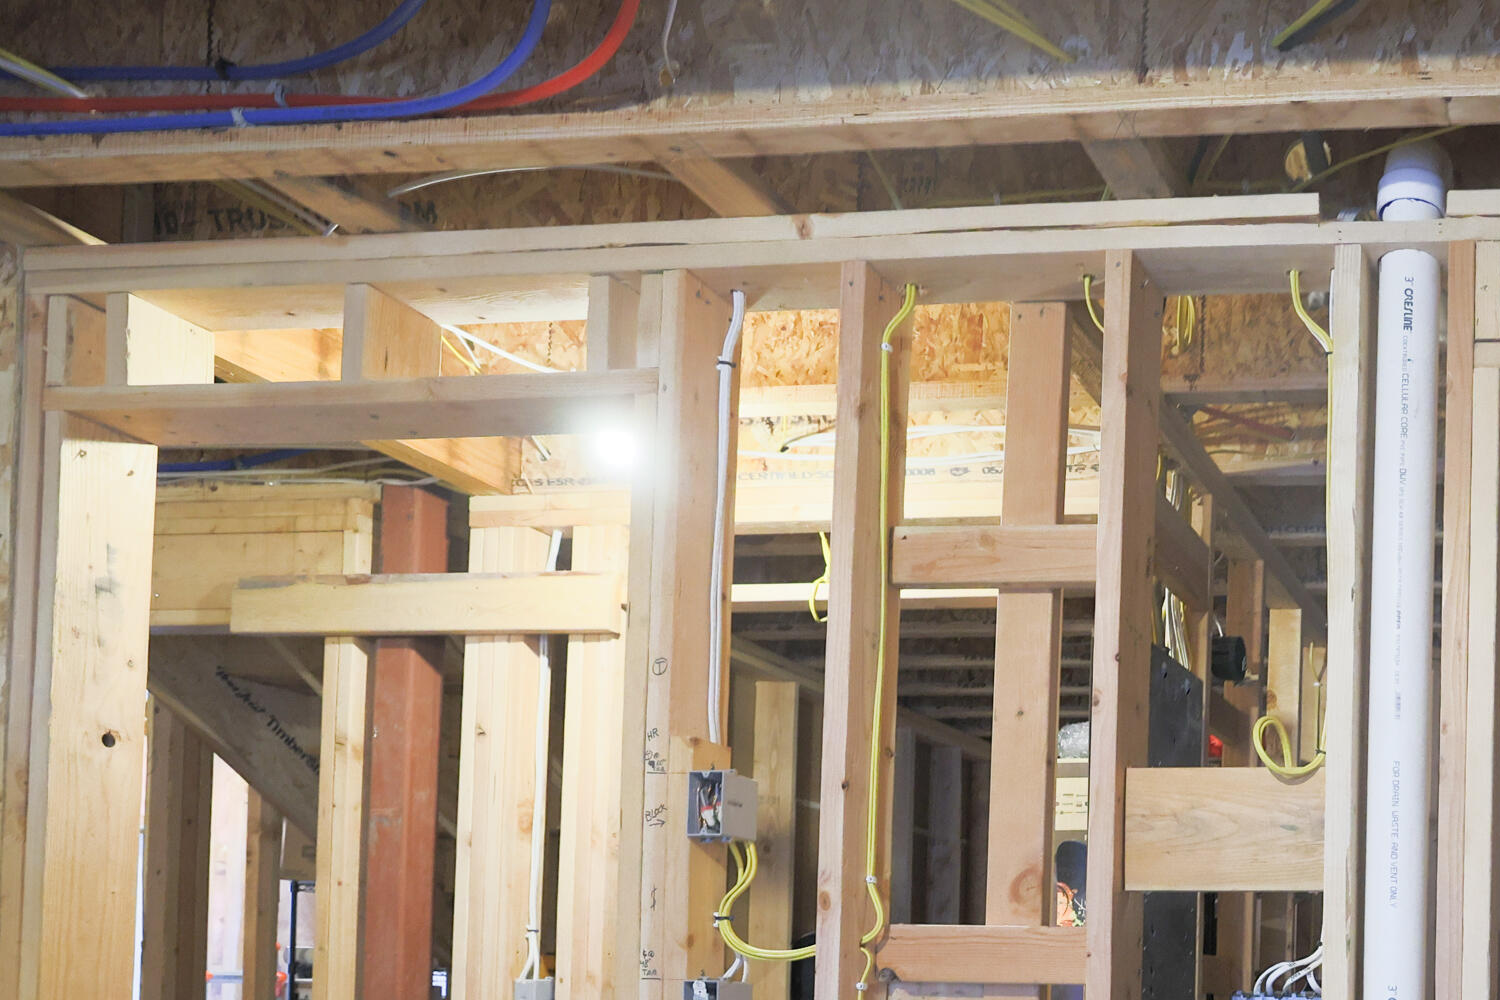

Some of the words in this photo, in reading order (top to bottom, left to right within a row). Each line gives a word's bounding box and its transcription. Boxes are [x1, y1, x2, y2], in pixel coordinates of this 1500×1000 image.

[1402, 288, 1414, 331] CRESLINE
[1400, 373, 1410, 414] CELLULAR
[1400, 416, 1408, 438] CORE
[1399, 468, 1408, 485] DWV
[1392, 760, 1400, 778] FOR
[1391, 780, 1400, 806] DRAIN
[1390, 810, 1399, 838] WASTE
[1390, 842, 1398, 860] AND
[1390, 861, 1398, 885] VENT
[1389, 886, 1398, 908] ONLY
